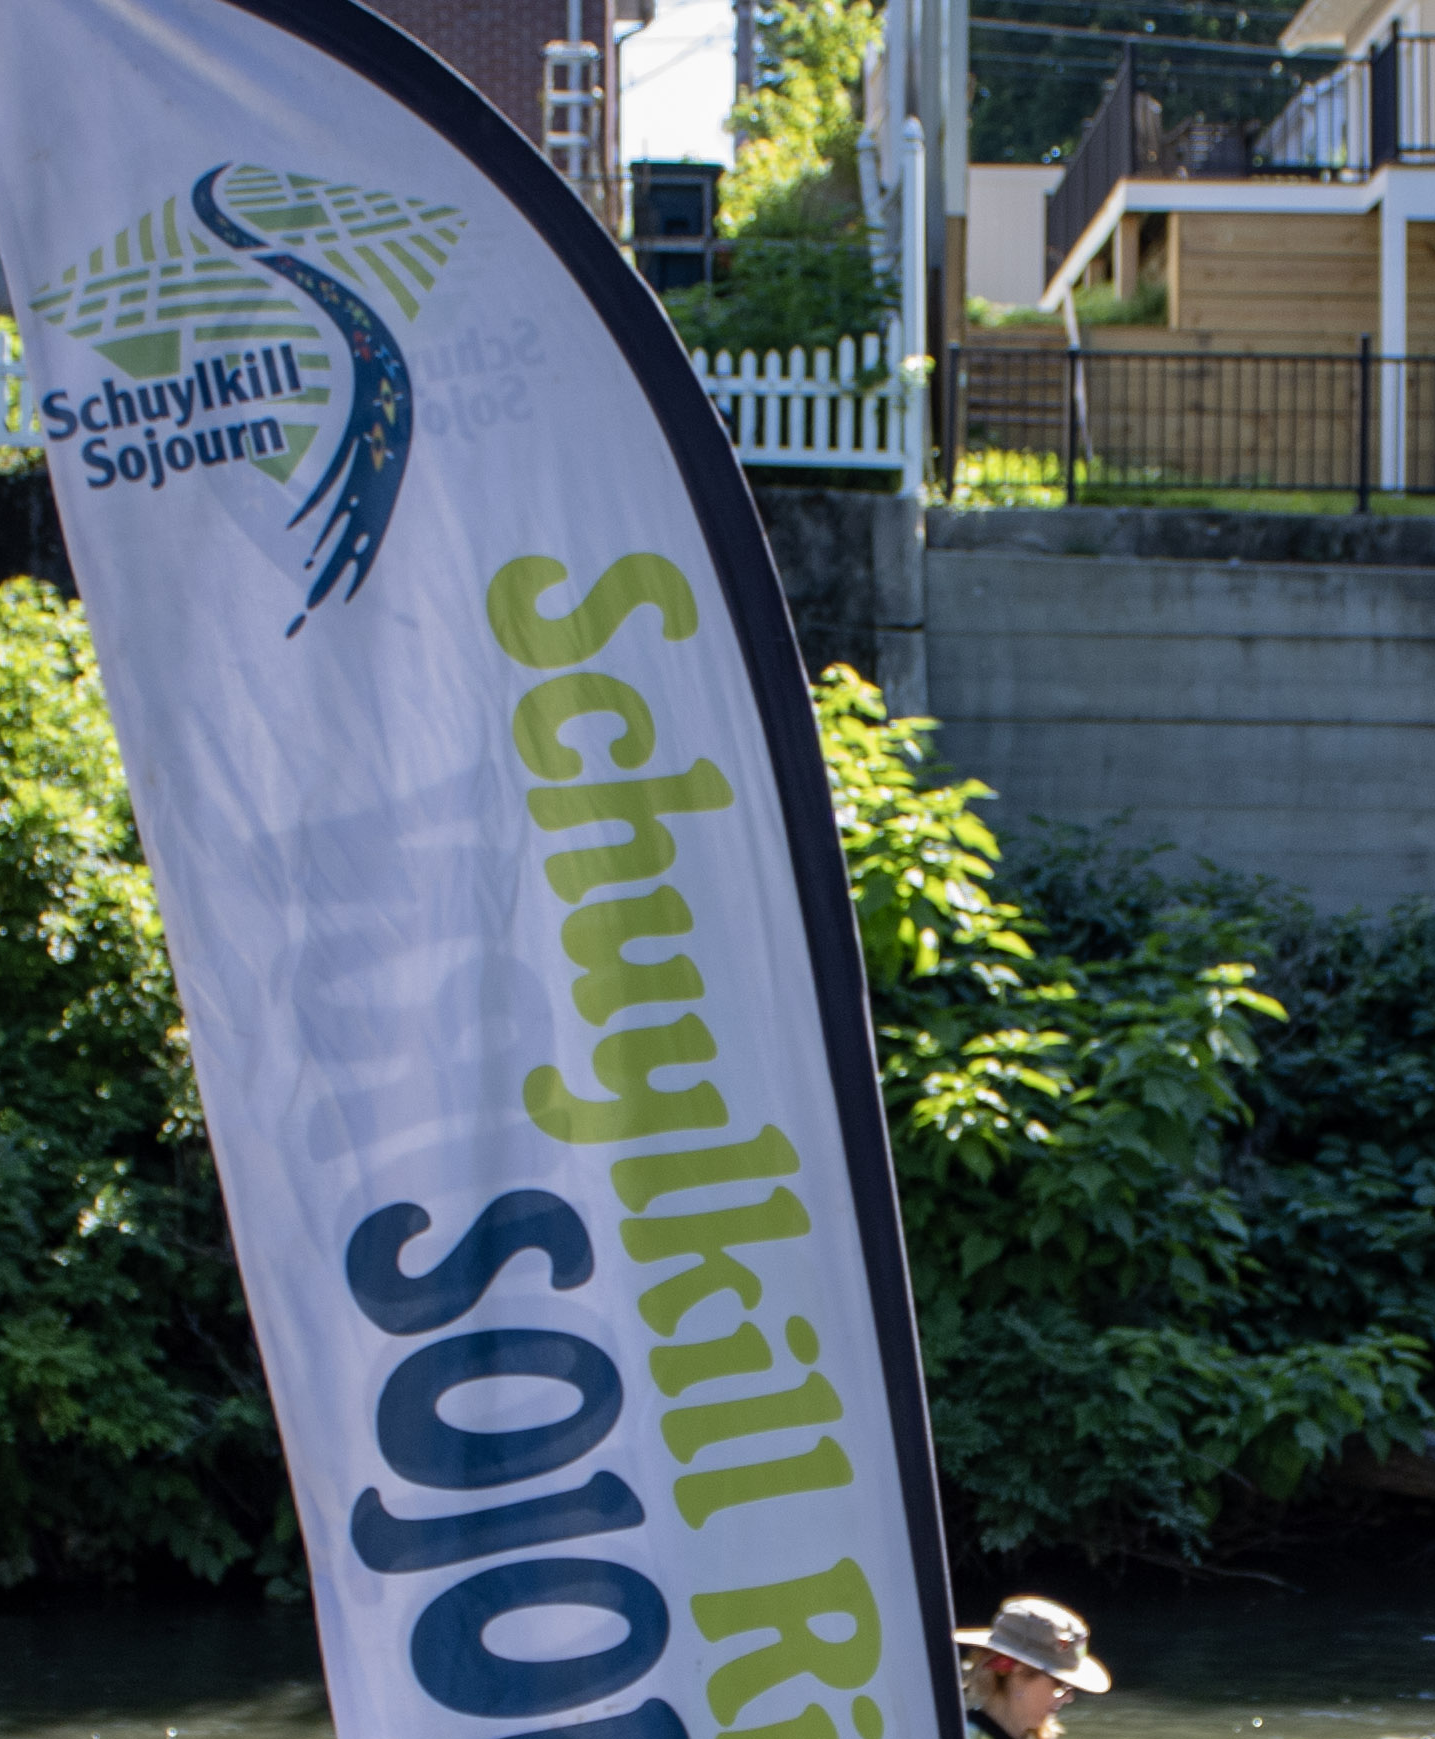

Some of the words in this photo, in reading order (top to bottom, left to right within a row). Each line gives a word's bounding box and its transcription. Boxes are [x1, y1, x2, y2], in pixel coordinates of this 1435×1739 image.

[41, 344, 302, 440] Schuylkill
[80, 416, 285, 489] Sojourn
[485, 552, 853, 1530] Schuylkill
